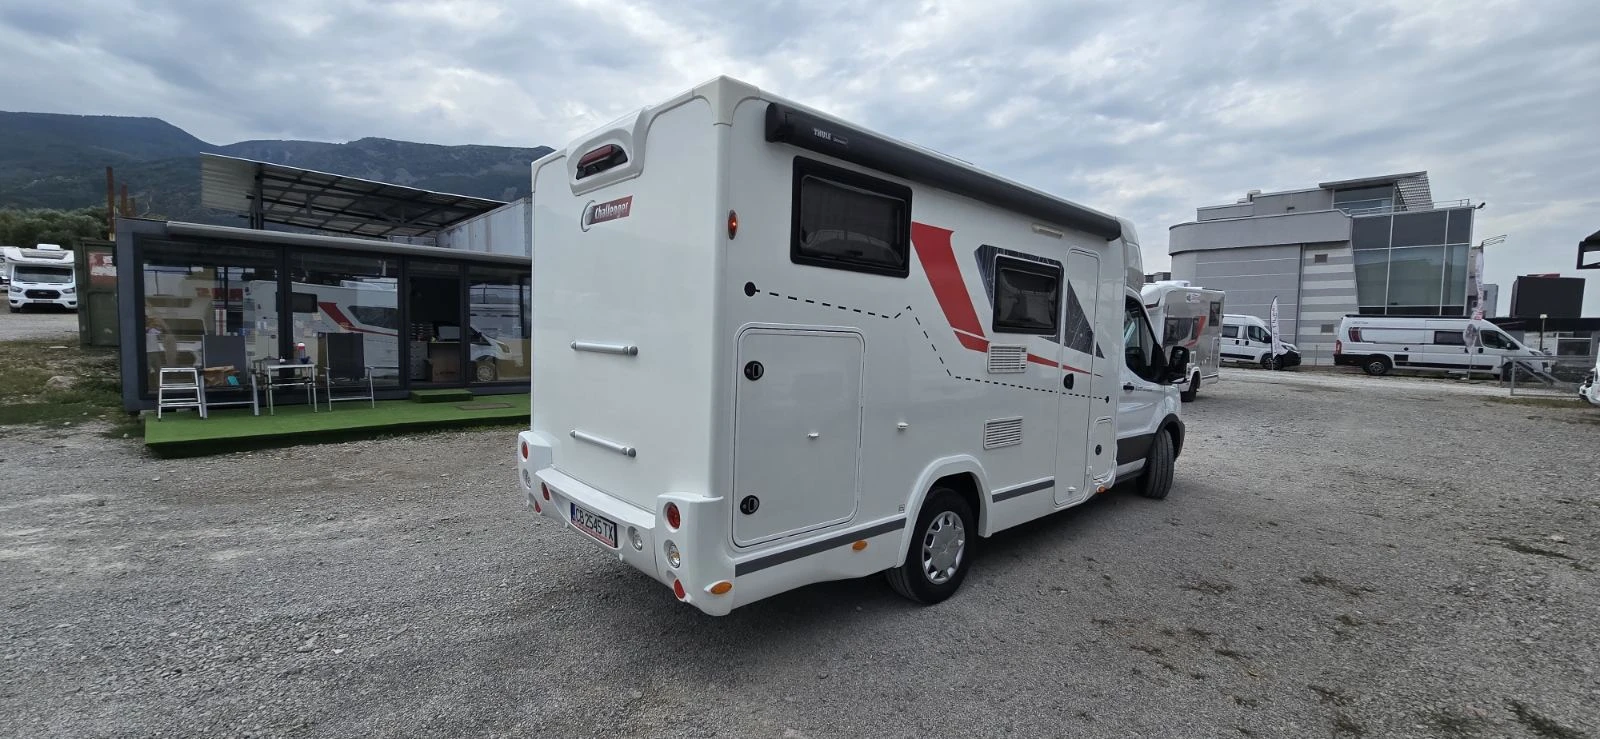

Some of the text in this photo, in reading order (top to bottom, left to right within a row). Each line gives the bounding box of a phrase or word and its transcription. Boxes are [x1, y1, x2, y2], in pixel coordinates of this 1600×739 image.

[814, 128, 831, 140] THULE
[595, 202, 629, 219] Challenger
[576, 508, 585, 524] CB
[585, 513, 602, 534] 2545
[603, 522, 614, 541] TX
